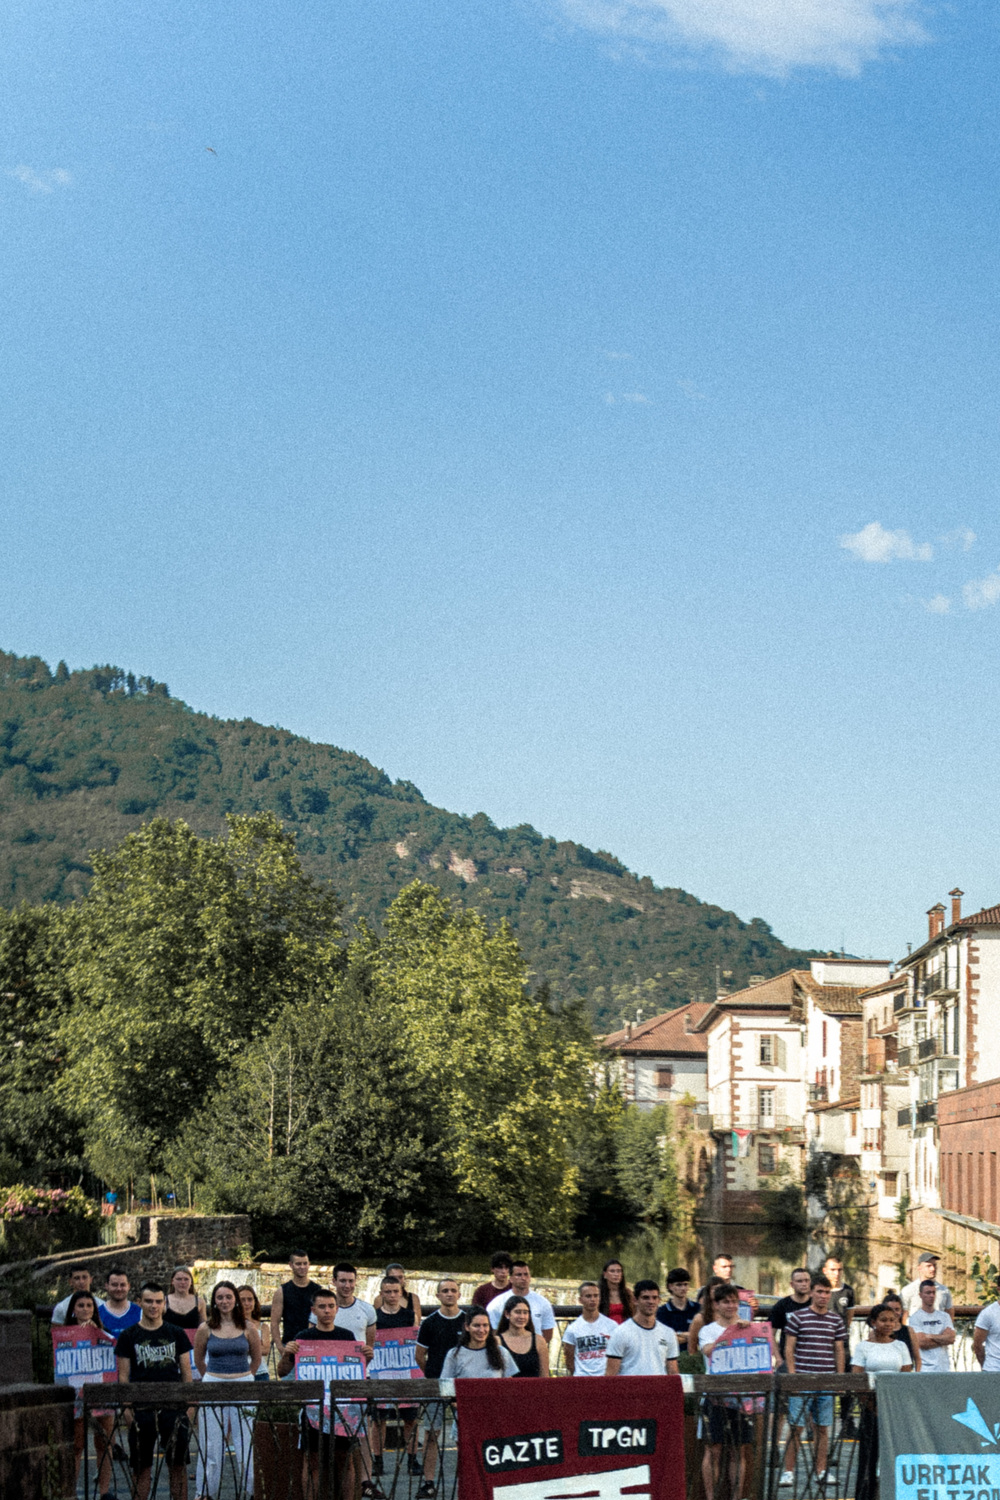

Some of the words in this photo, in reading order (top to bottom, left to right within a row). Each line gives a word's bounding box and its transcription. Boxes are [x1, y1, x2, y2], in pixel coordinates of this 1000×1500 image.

[57, 1346, 115, 1375] SOZIALISTA
[711, 1344, 769, 1373] SOZIALISTA
[486, 1437, 559, 1466] GAZTE
[588, 1427, 647, 1448] TPGN
[902, 1464, 991, 1485] URRIAK
